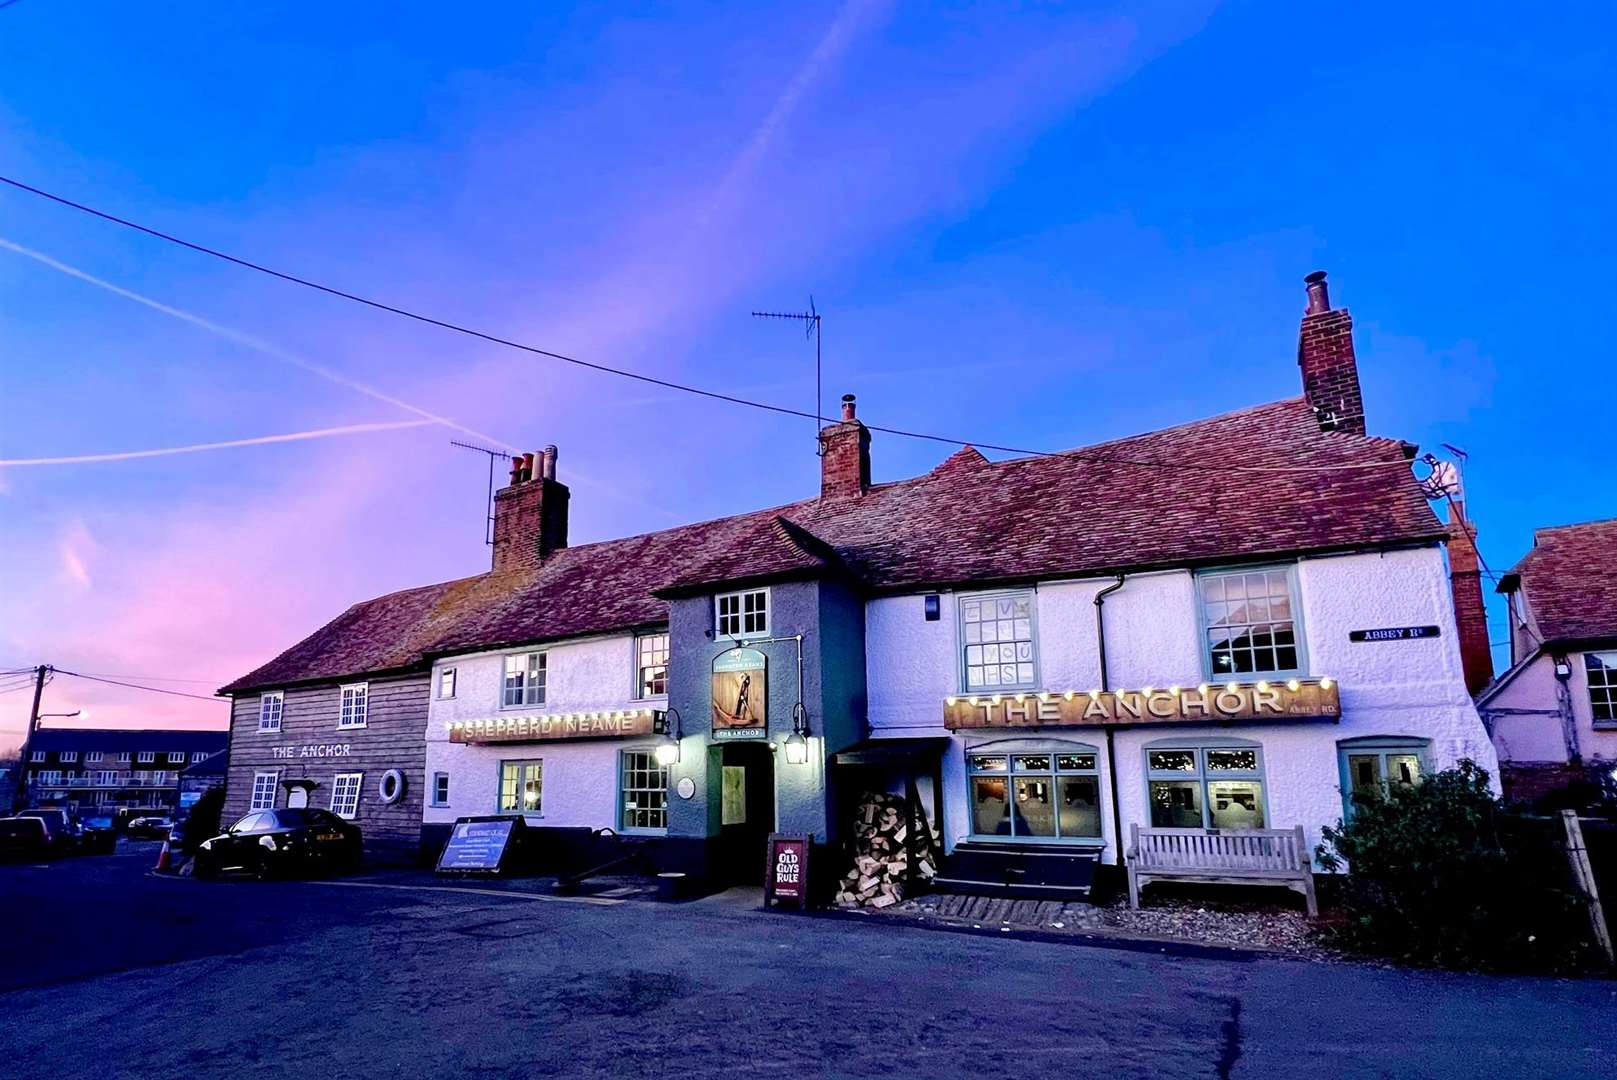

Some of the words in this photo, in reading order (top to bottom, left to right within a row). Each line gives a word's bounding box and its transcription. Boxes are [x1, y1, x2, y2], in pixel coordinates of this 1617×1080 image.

[1364, 629, 1404, 640] ABBEY
[977, 700, 1061, 722] THE
[1083, 688, 1284, 719] ANCHOR
[464, 720, 553, 738] SHEPHERD
[565, 715, 633, 733] NEAME
[272, 747, 295, 759] THE
[300, 744, 351, 758] ANCHOR
[778, 853, 799, 863] OLD
[776, 863, 800, 873] GUYS
[776, 873, 800, 883] RULE
